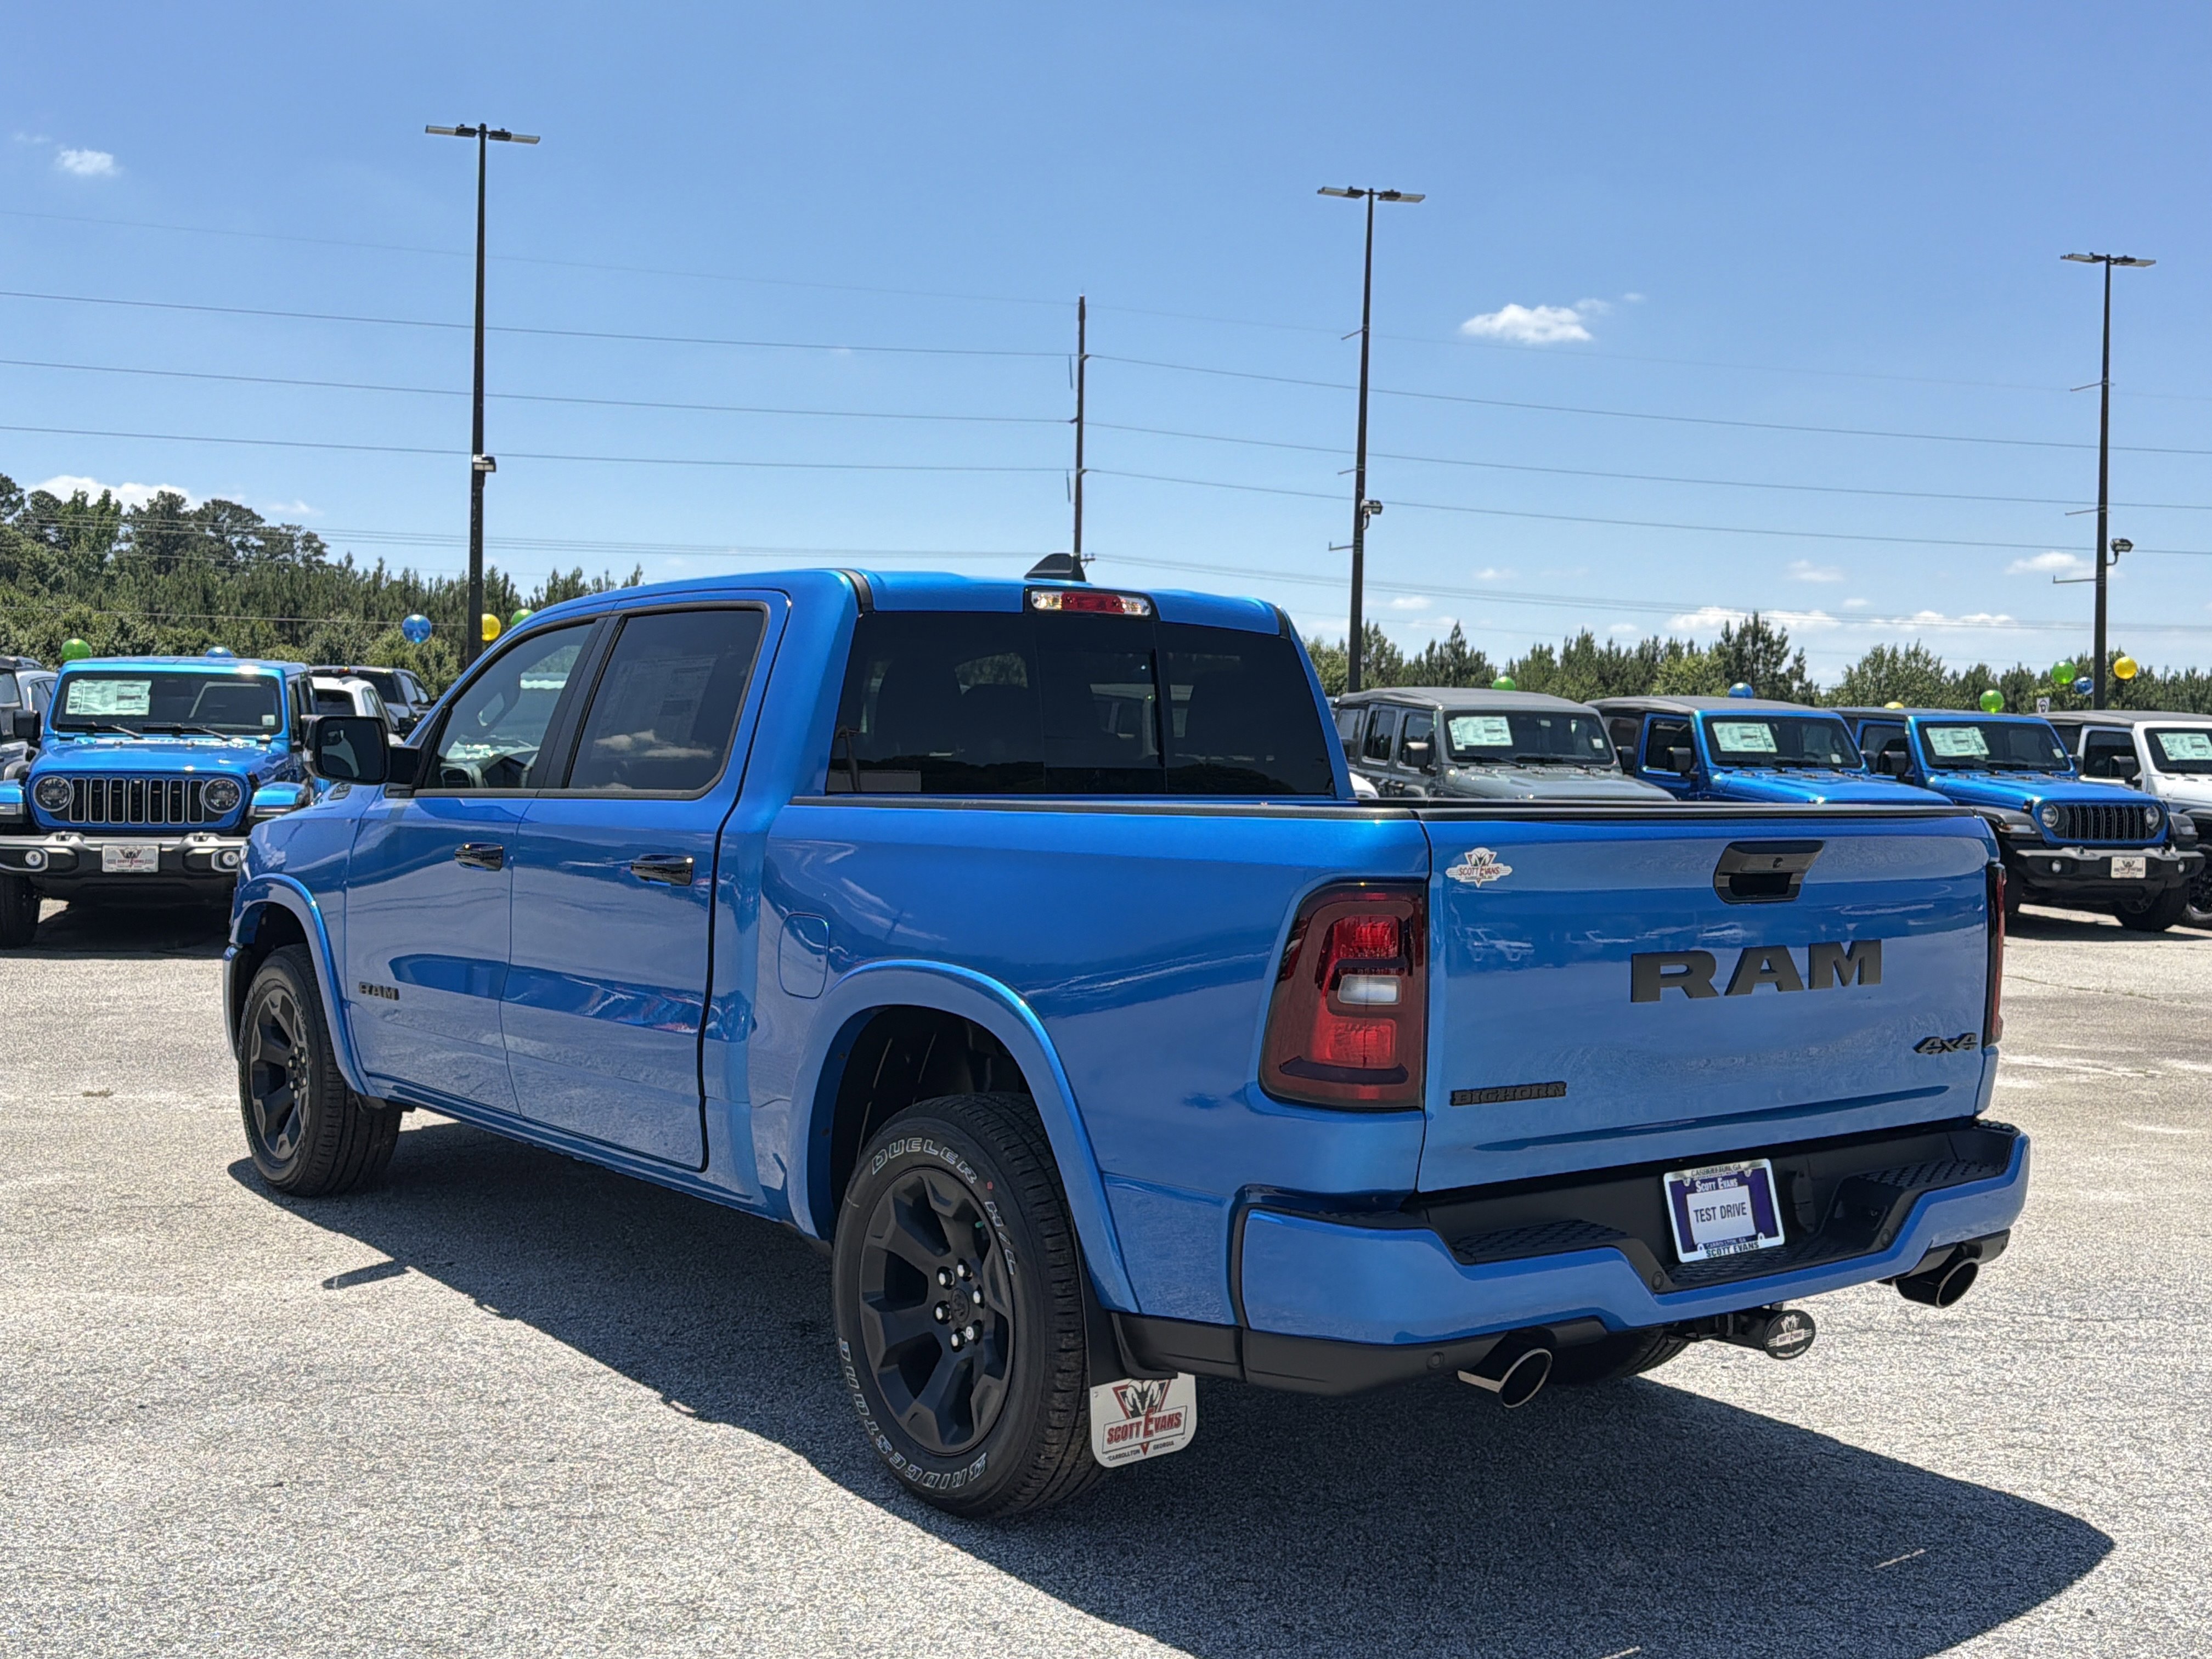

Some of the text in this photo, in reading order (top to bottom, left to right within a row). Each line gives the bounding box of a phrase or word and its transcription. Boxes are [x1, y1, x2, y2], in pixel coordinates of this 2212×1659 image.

[1458, 867, 1479, 876] SCOTT
[1630, 939, 1882, 1003] RAM
[359, 981, 400, 1001] RAM
[871, 1137, 978, 1184] DUELER
[1695, 1177, 1738, 1193] SCOTT EVANS
[1693, 1202, 1747, 1223] TEST DRIVE
[1706, 1242, 1759, 1258] SCOTT EVANS
[838, 1337, 987, 1490] BRIDGESTONE
[1107, 1407, 1182, 1445] SCOTT EVANS
